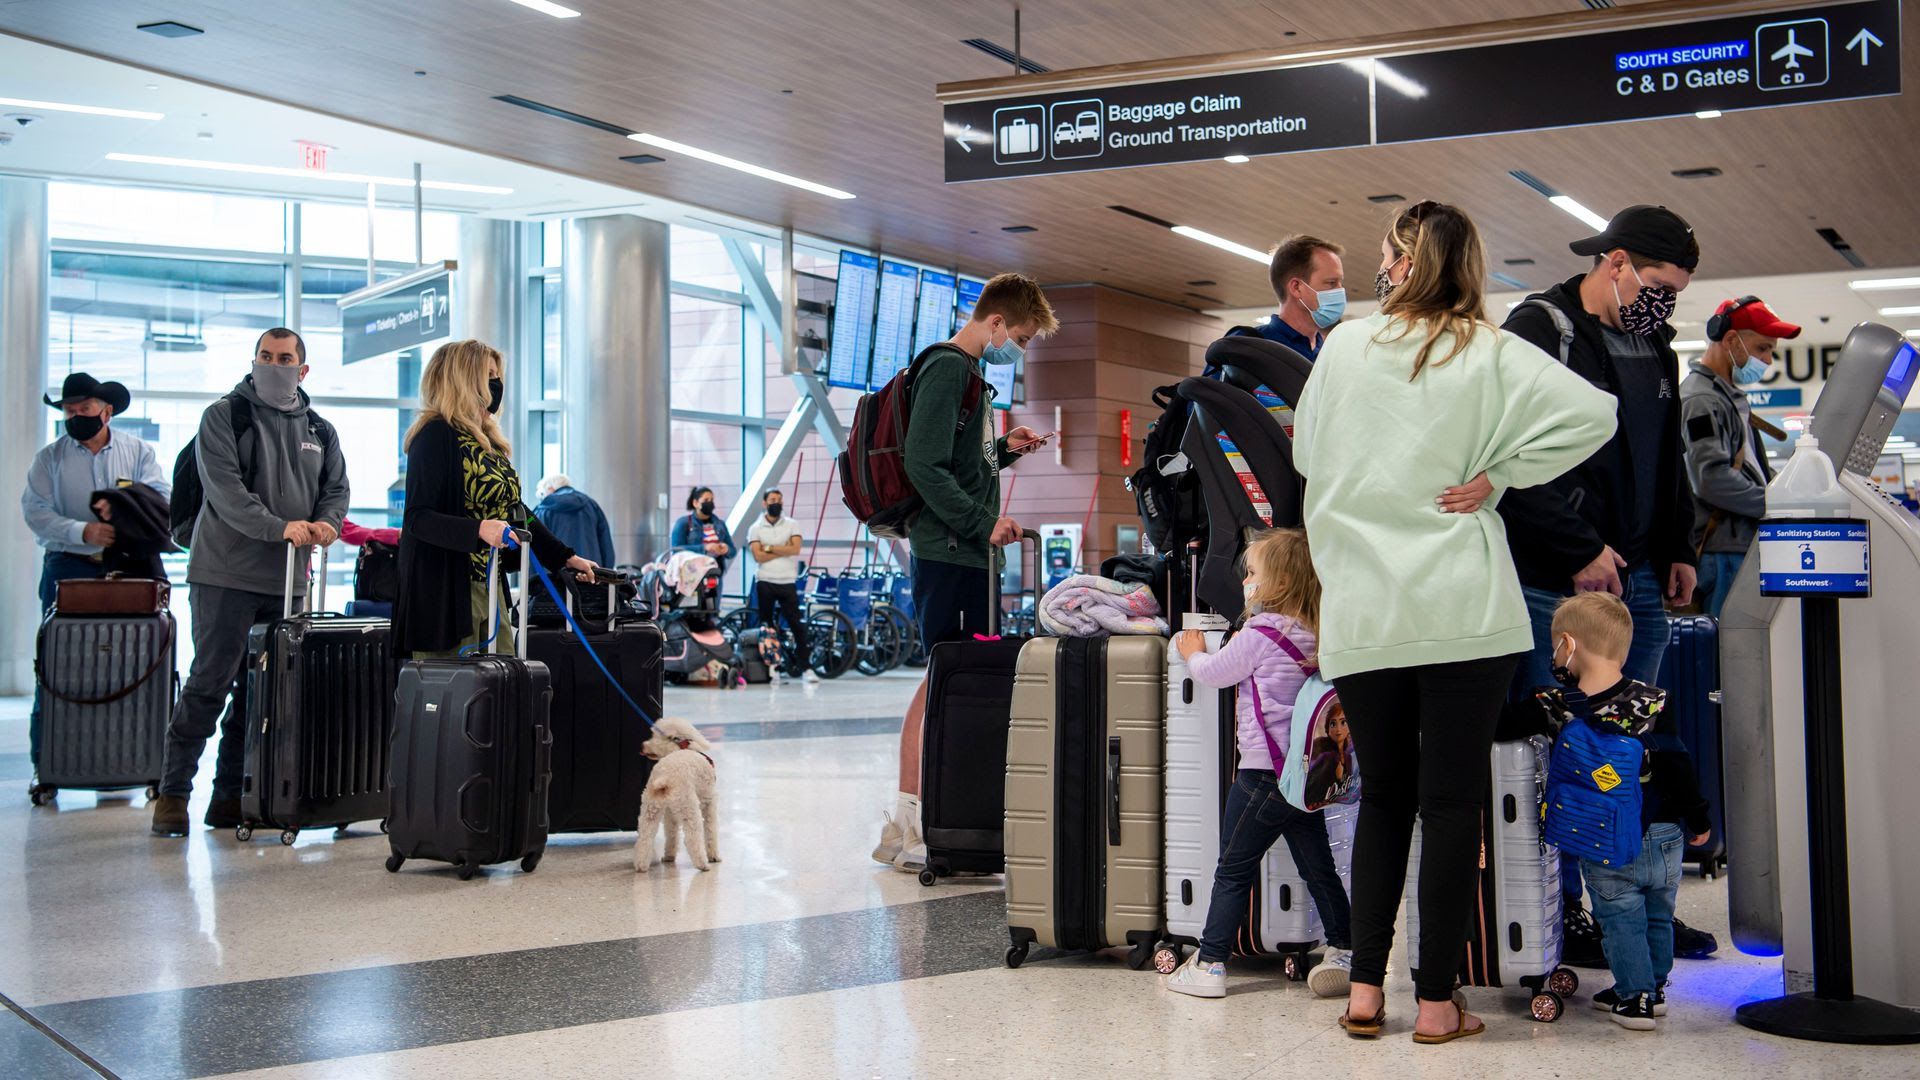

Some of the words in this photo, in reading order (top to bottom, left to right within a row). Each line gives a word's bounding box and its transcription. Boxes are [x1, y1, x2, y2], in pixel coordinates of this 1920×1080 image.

[1619, 53, 1668, 69] SOUTH
[1671, 43, 1744, 64] SECURITY
[1616, 77, 1633, 96] C
[1639, 74, 1656, 93] &
[1662, 72, 1679, 91] D
[1685, 67, 1750, 88] Gates
[1781, 74, 1791, 84] C
[1794, 73, 1805, 83] D
[1108, 101, 1186, 123] Baggage
[1190, 94, 1241, 113] Claim
[1108, 127, 1173, 149] Ground
[1178, 115, 1306, 143] Transportation
[305, 146, 327, 169] EXIT
[1777, 530, 1812, 539] Sanitizing
[1813, 529, 1841, 537] Station
[1785, 578, 1829, 586] Southwest
